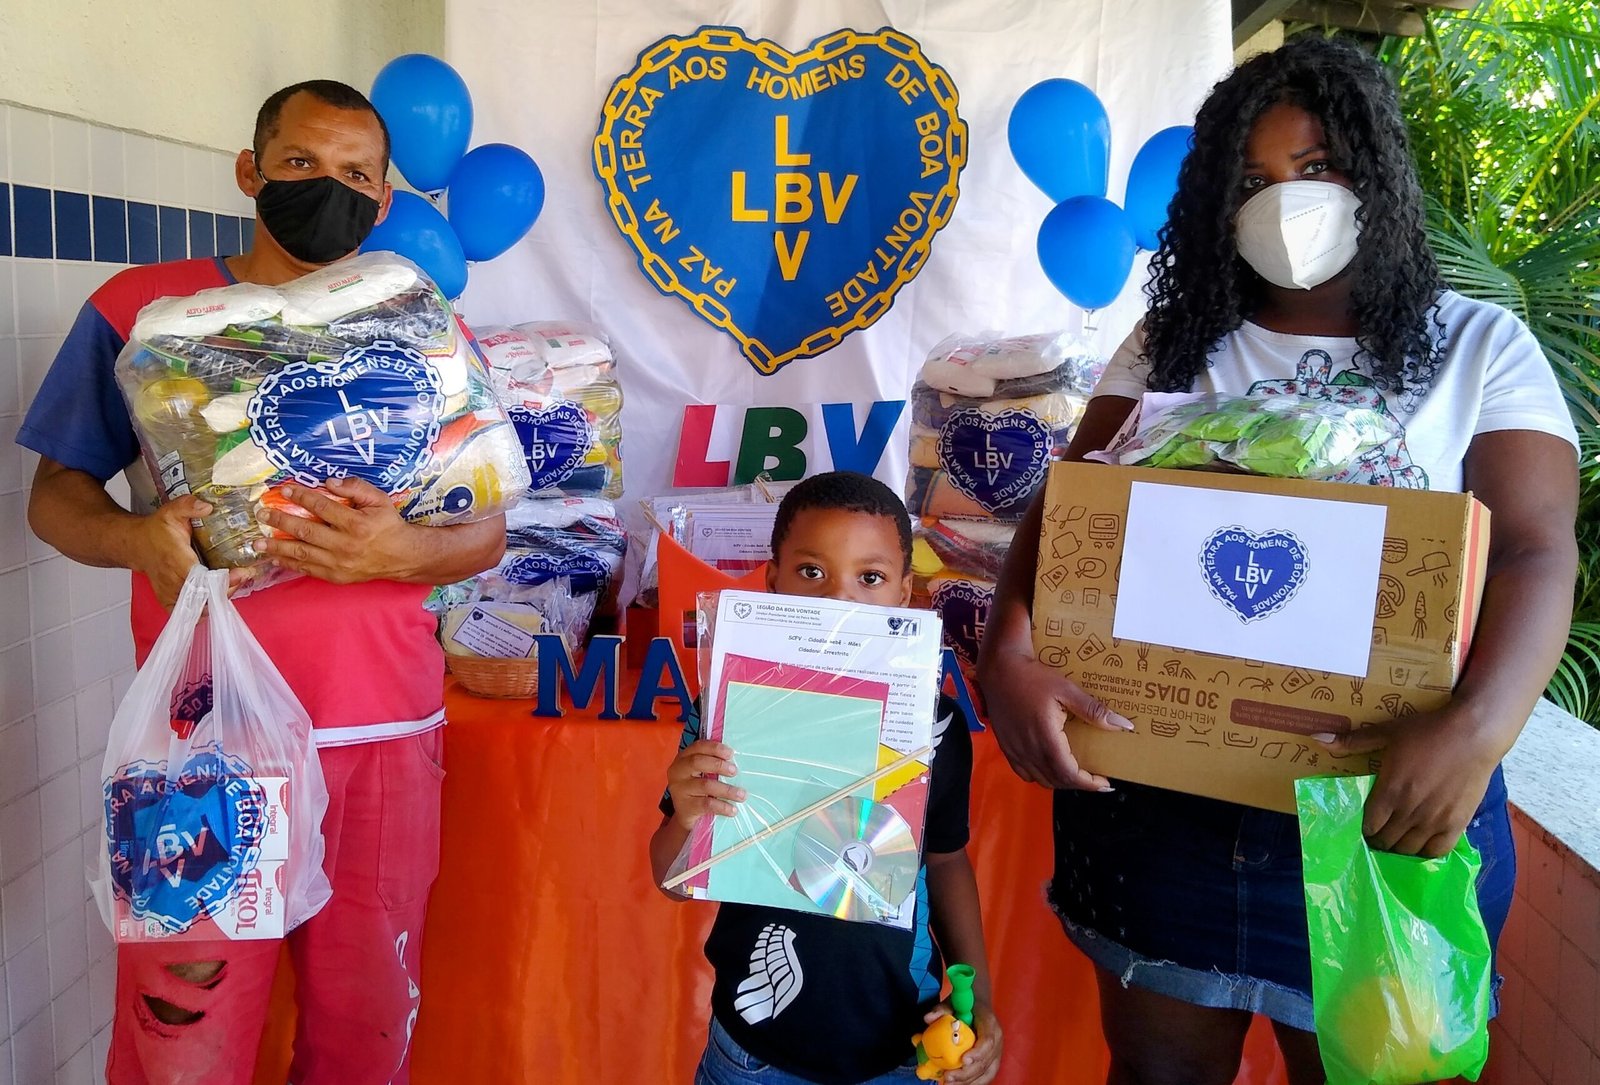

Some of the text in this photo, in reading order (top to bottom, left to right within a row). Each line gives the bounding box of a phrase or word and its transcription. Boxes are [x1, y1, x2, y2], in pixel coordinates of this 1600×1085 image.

[620, 54, 945, 319] PAZ NA TERRA AOS HOMENS DE BOA VONTADE
[730, 170, 860, 226] LBV
[327, 279, 341, 290] ALTO
[186, 307, 202, 316] ALTO
[263, 354, 431, 486] PAZ NA TERRA AOS HOMENS DE BOA VONTADE
[326, 406, 390, 447] LBV
[512, 410, 586, 487] OS HOMENS DE BOA VONTADE
[672, 399, 907, 488] LBV
[944, 416, 1045, 502] PAZ NA TERRA AOS HOMENS DE BOA VONTADE
[973, 451, 1014, 470] LBV
[524, 560, 548, 570] AOS
[548, 559, 591, 574] HOMENS
[590, 564, 603, 578] DE
[1206, 533, 1303, 613] PAZ NA TERRA AOS HOMENS DE BOA VONTADE
[1234, 565, 1274, 585] LBV
[796, 608, 821, 616] VONTADE
[950, 589, 971, 601] AOS
[970, 592, 993, 609] HOM
[788, 634, 803, 642] SCFV
[1081, 680, 1141, 697] A PARTIR DA DATA
[1082, 671, 1142, 688] DE FABRICAÇÃO
[1144, 681, 1220, 710] 30 DIAS
[1169, 707, 1216, 726] MELHOR
[234, 800, 250, 839] BOA
[268, 804, 279, 835] Integral
[264, 886, 276, 916] Integral
